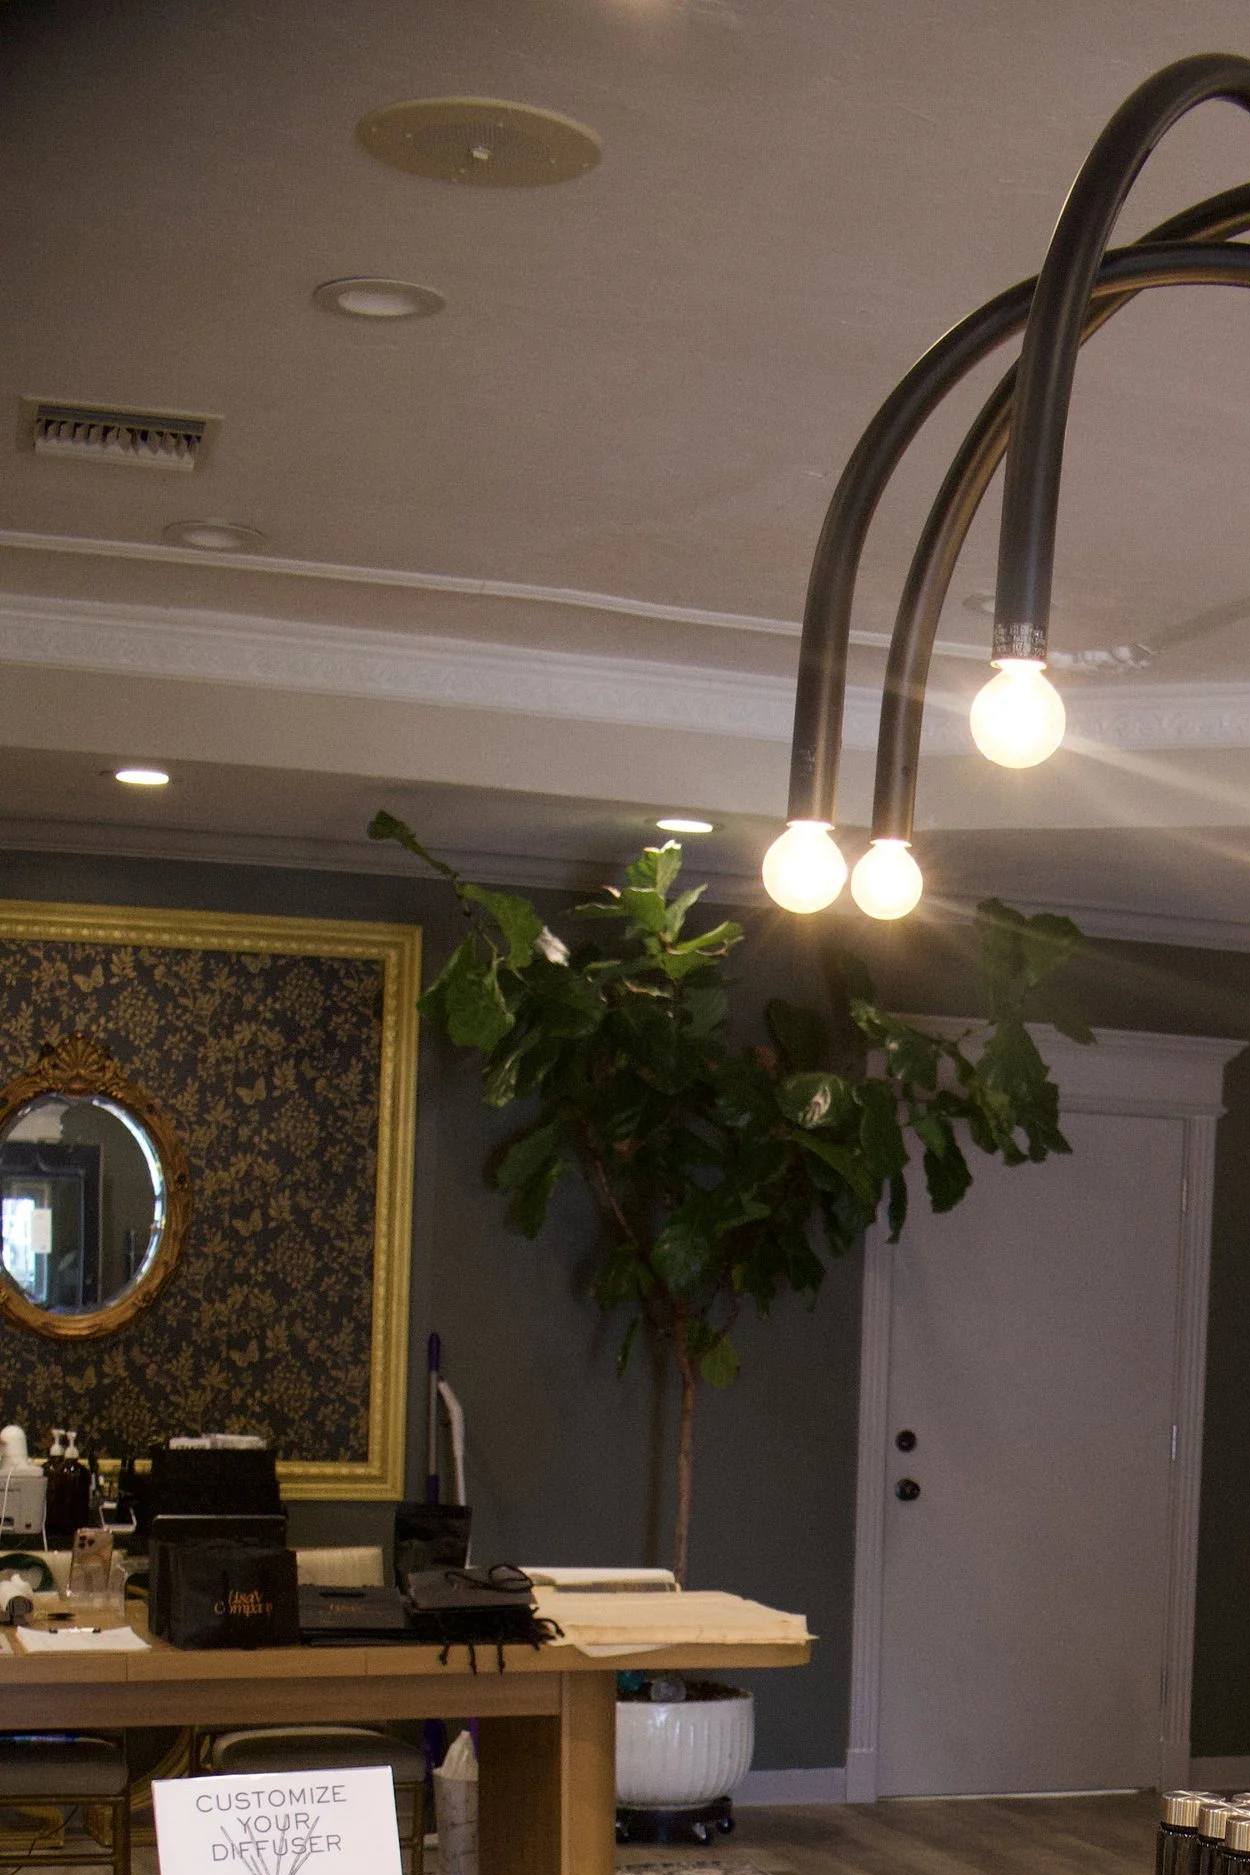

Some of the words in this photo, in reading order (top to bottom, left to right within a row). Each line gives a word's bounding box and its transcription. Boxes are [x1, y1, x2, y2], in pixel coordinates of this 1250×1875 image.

[196, 1785, 347, 1813] CUSTOMIZE
[237, 1812, 310, 1834] YOUR
[212, 1834, 342, 1861] DIFFUSER
